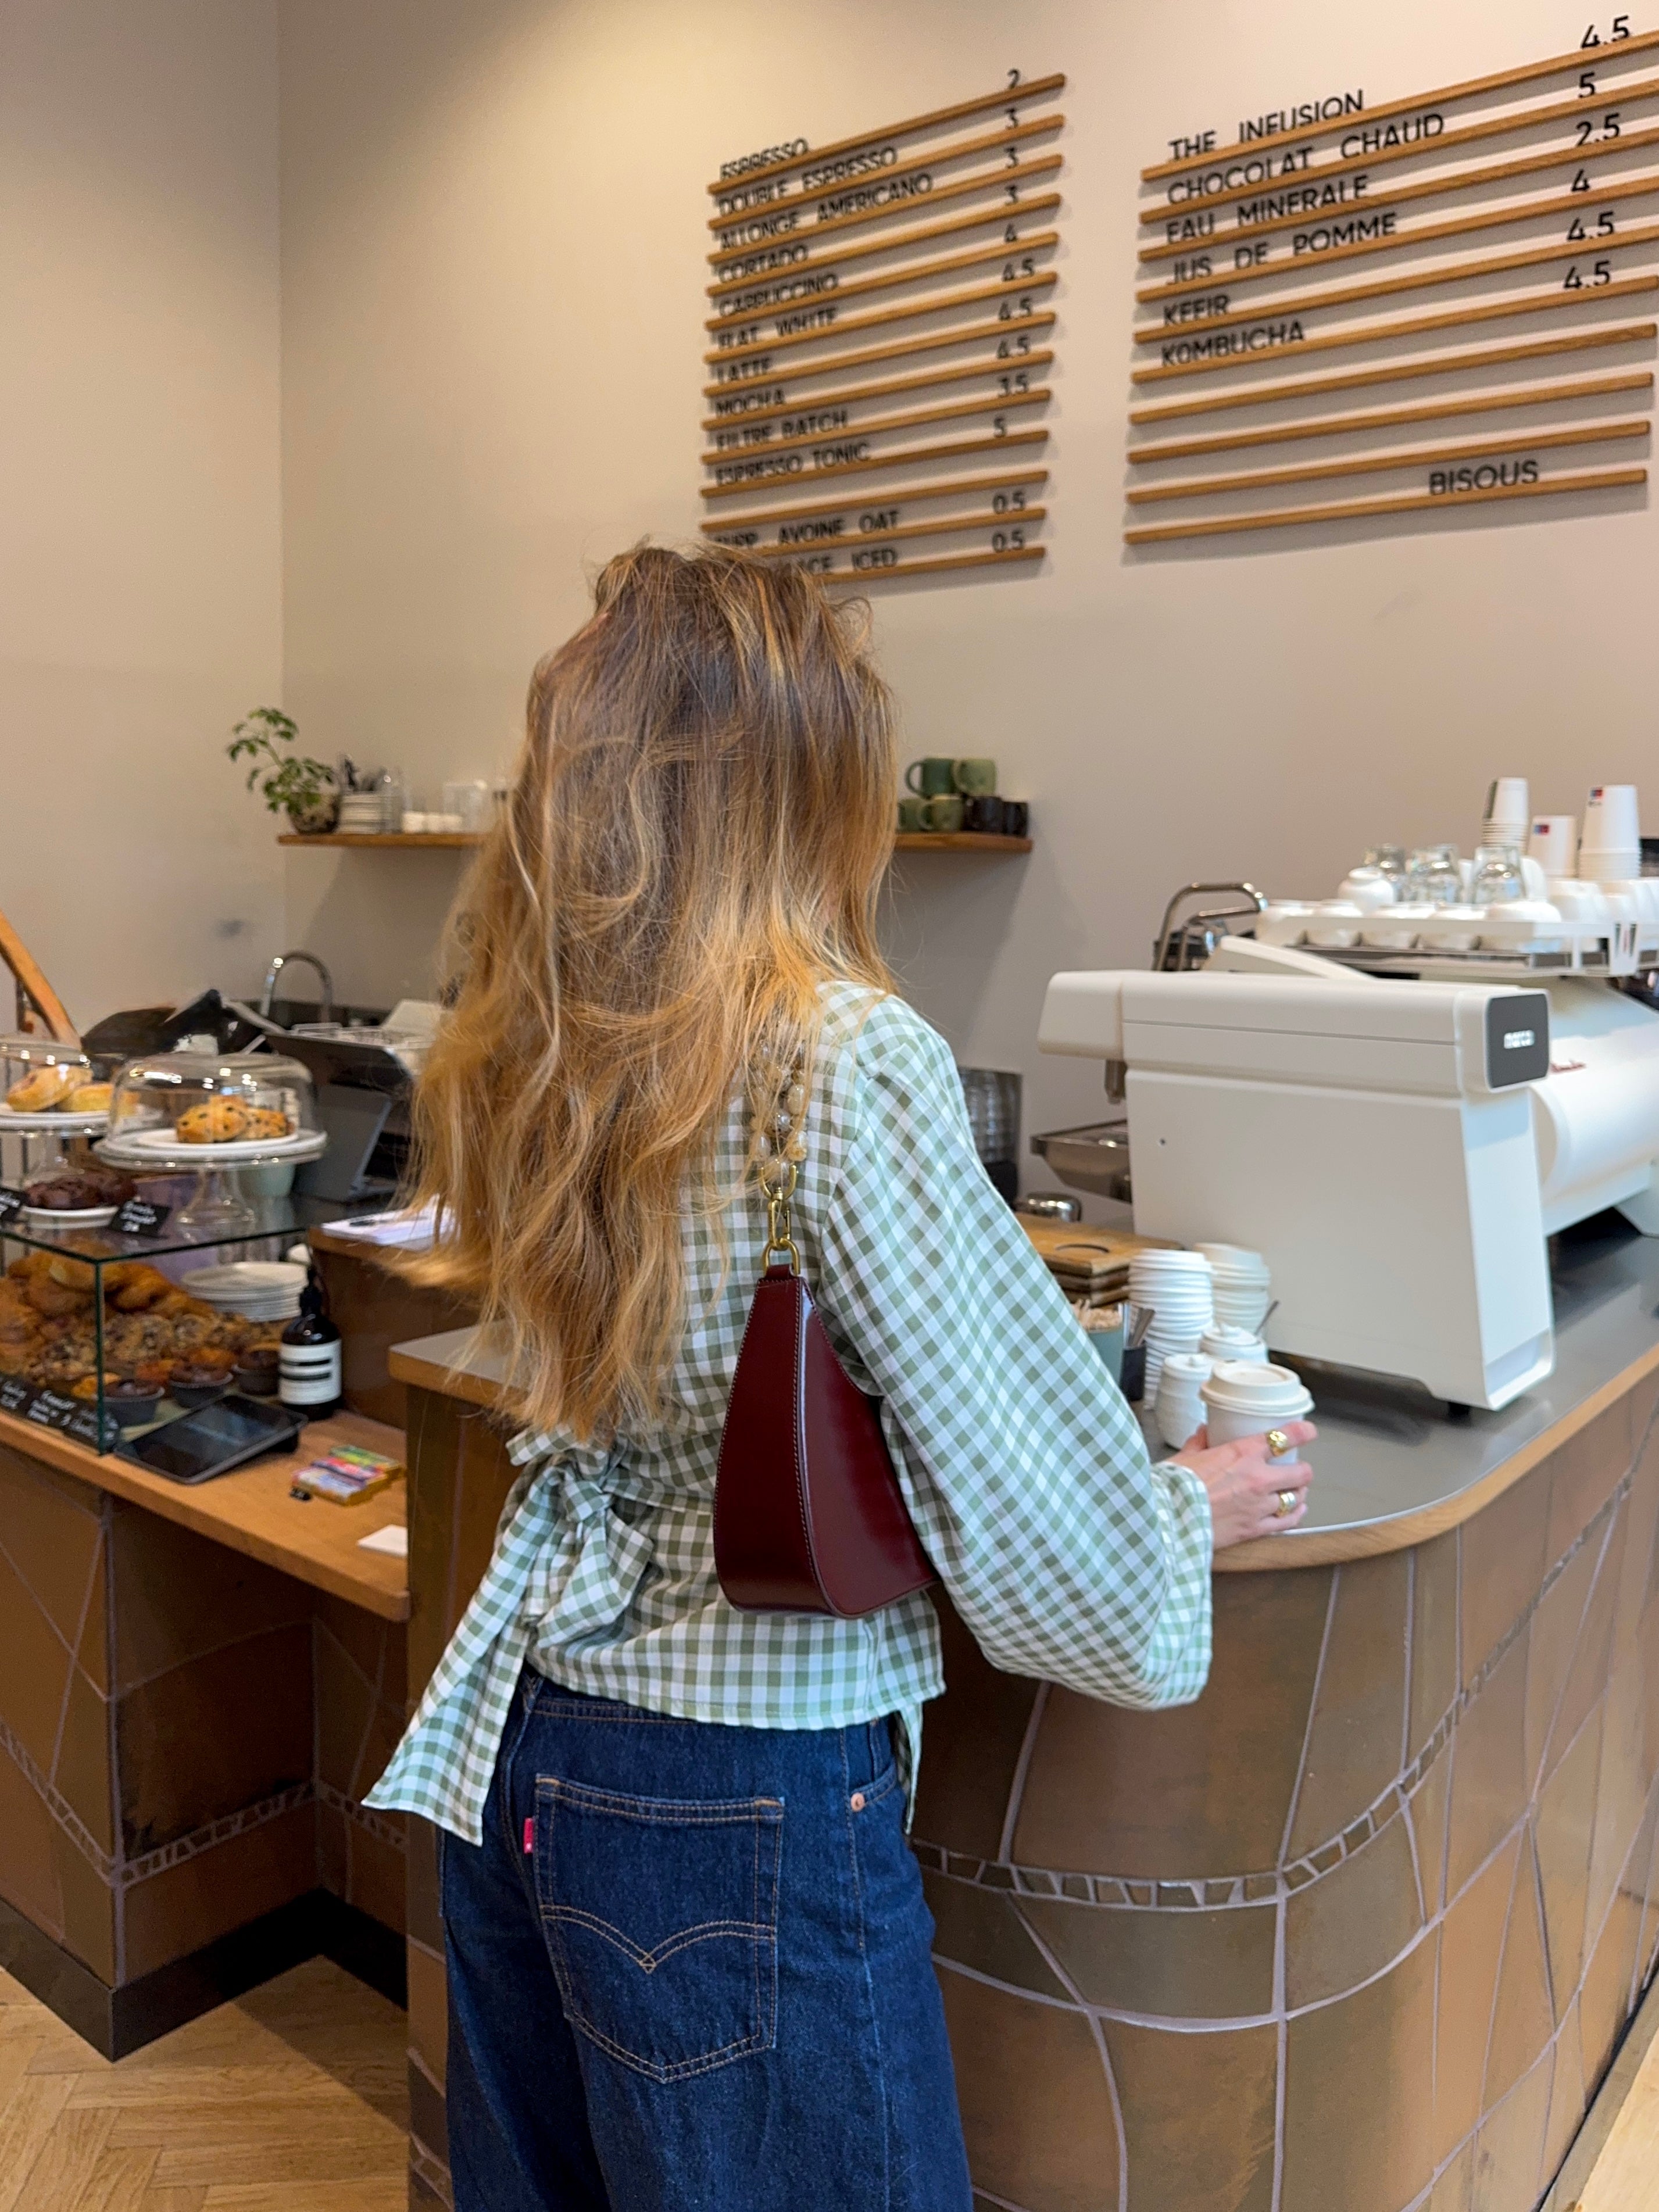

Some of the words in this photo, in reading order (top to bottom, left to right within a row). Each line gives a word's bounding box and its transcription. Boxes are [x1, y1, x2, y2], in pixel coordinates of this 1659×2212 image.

[1169, 130, 1217, 161] THE
[1238, 89, 1364, 144] INFUSION
[1580, 15, 1629, 49] 4.5
[802, 146, 897, 191] ESPRESSO
[1004, 108, 1018, 130] 3
[1168, 146, 1314, 205] CHOCOLAT
[1340, 114, 1445, 160] CHAUD
[1578, 71, 1595, 98] 5
[817, 174, 932, 223] AMERICANO
[1004, 146, 1018, 169] 3
[1166, 213, 1215, 244] EAU
[1237, 174, 1368, 227] MINERALE
[1576, 113, 1619, 148] 2.5
[1166, 256, 1212, 286] JUS
[1234, 241, 1269, 270] DE
[1293, 212, 1397, 256] POMME
[1571, 169, 1590, 192] 4
[718, 245, 807, 283] CORTADO
[718, 273, 838, 317] CAPPUCCINO
[1163, 293, 1230, 327] KEFIR
[1567, 211, 1614, 241] 4.5
[1162, 320, 1304, 367] KOMBUCHA
[1563, 259, 1611, 289] 4.5
[716, 389, 784, 418] MOCHA
[781, 409, 848, 439] BATCH
[812, 441, 871, 470] TONIC
[993, 417, 1007, 438] 5
[1429, 459, 1539, 495] BISOUS
[859, 509, 899, 534] OAT
[851, 547, 899, 571] ICED
